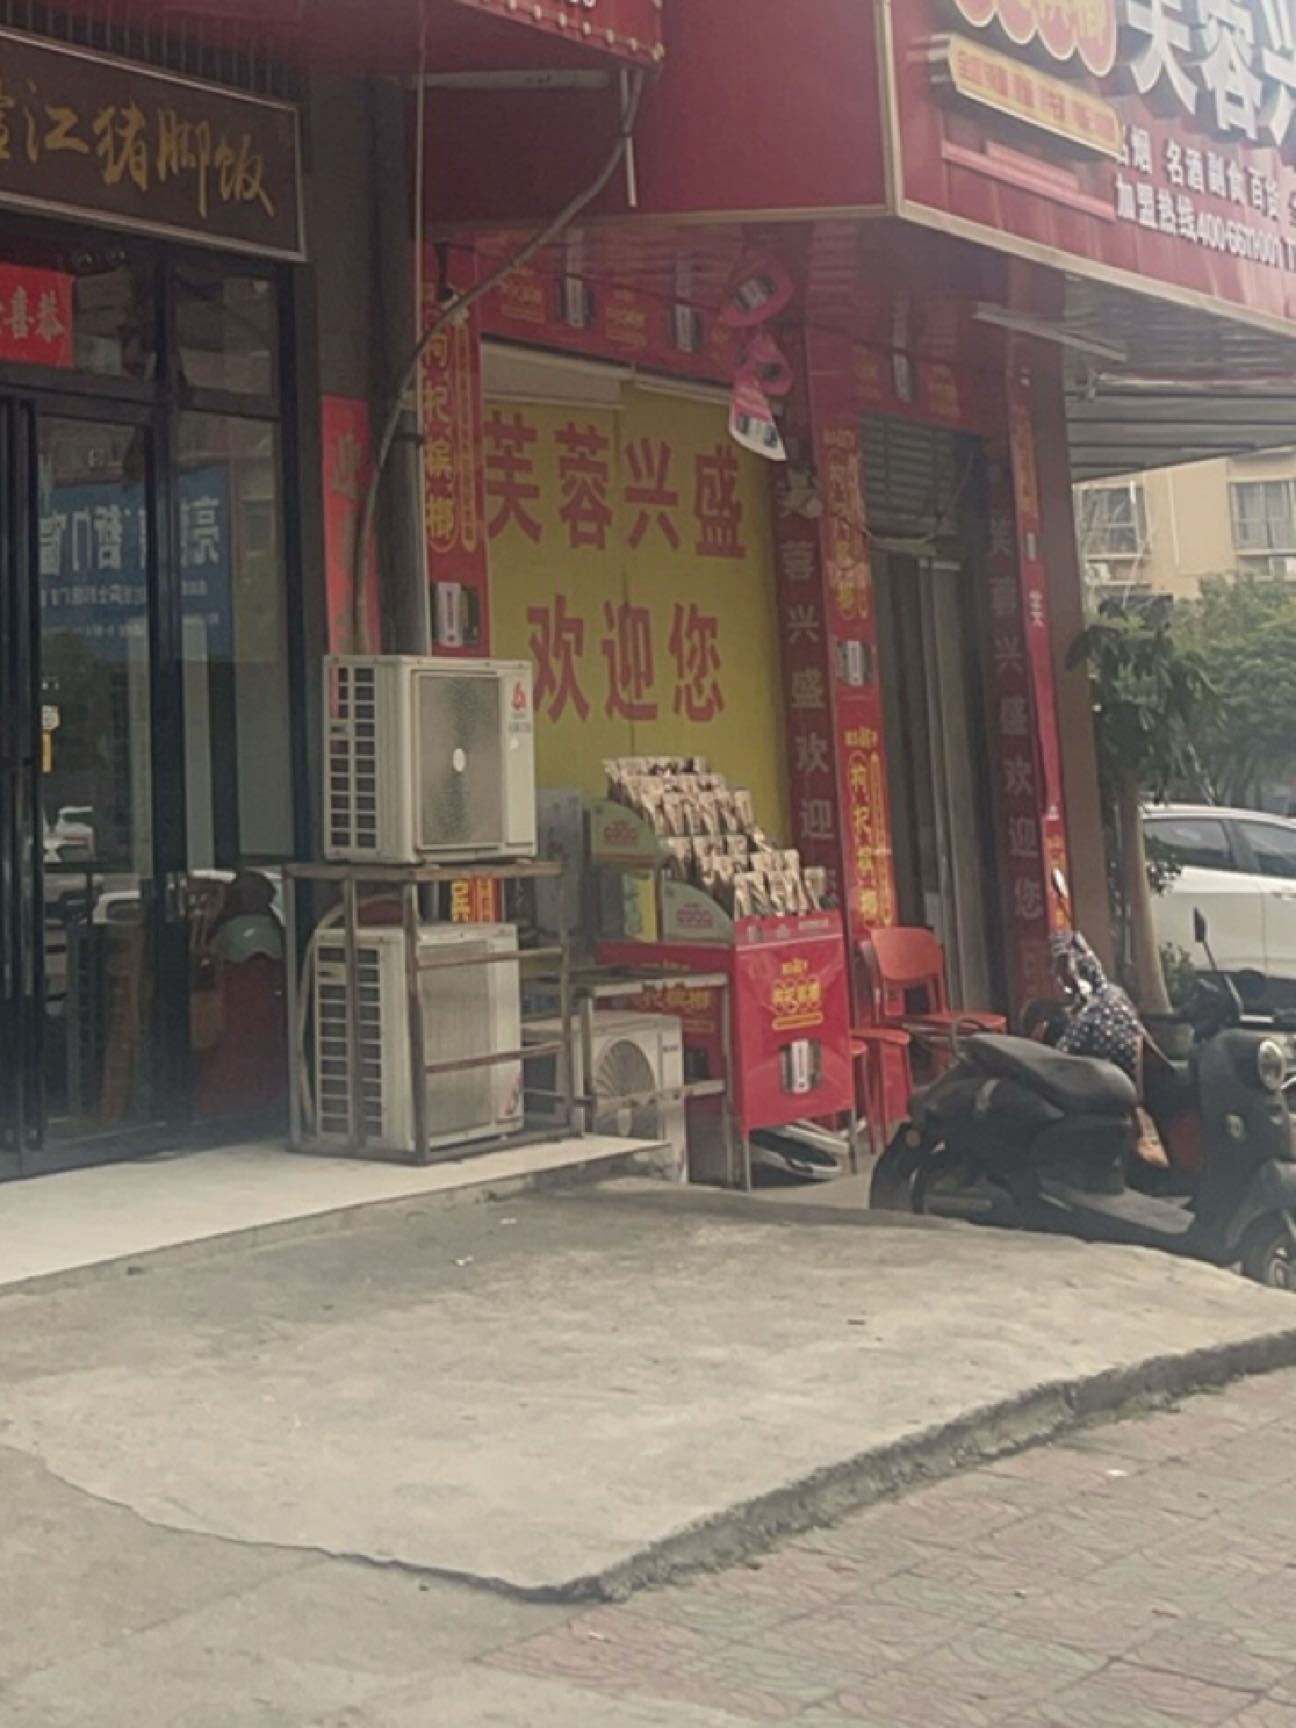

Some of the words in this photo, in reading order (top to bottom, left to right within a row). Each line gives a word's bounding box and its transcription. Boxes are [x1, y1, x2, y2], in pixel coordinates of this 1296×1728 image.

[483, 409, 747, 560] 芙蓉兴盛
[526, 594, 725, 724] 欢迎您
